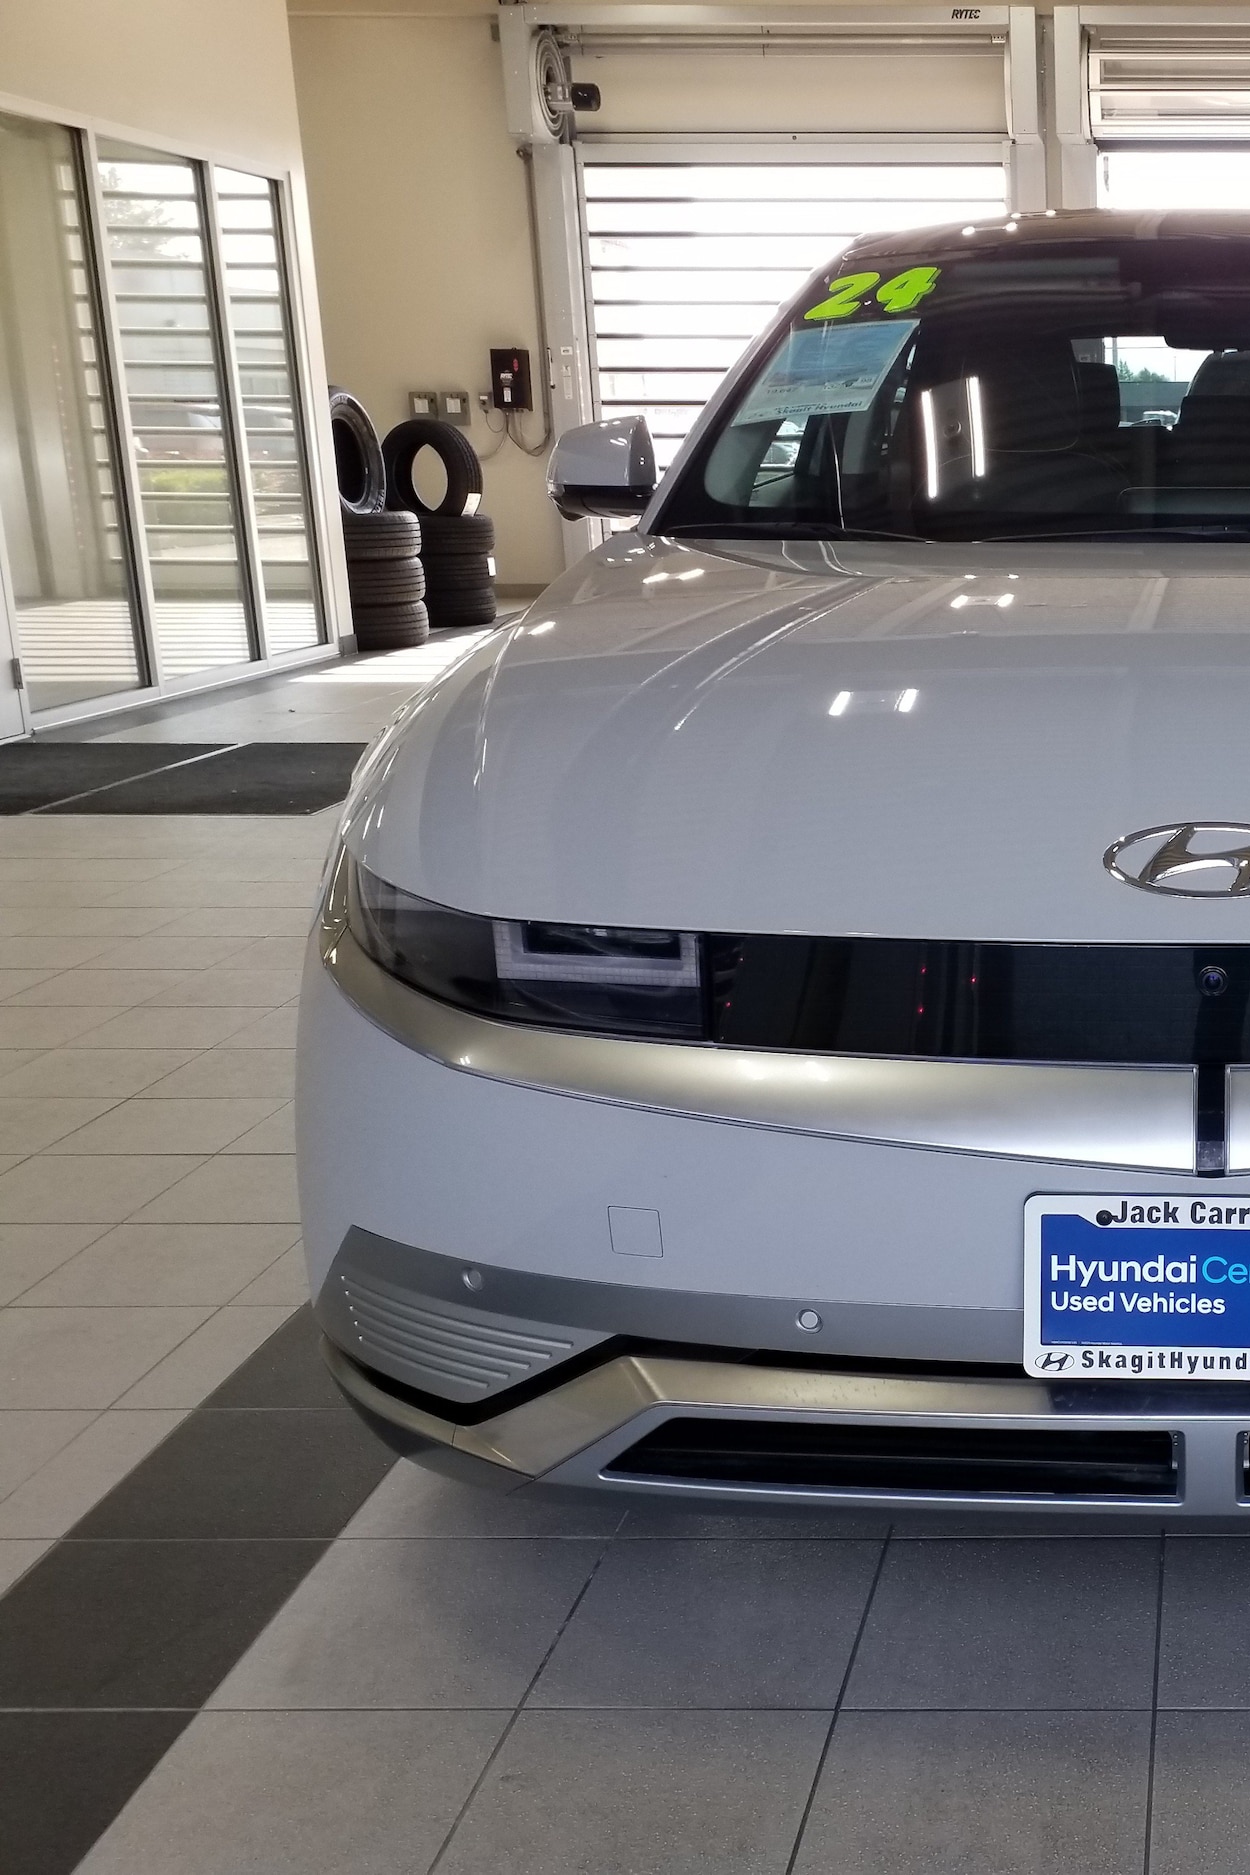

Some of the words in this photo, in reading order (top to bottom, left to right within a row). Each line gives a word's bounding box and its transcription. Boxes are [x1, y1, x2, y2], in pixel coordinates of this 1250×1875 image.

[951, 8, 981, 19] RYTEC
[803, 267, 942, 321] 24
[1111, 1200, 1180, 1225] Jack
[1050, 1254, 1197, 1287] Hyundai
[1050, 1290, 1115, 1312] Used
[1120, 1291, 1226, 1315] Vehicles
